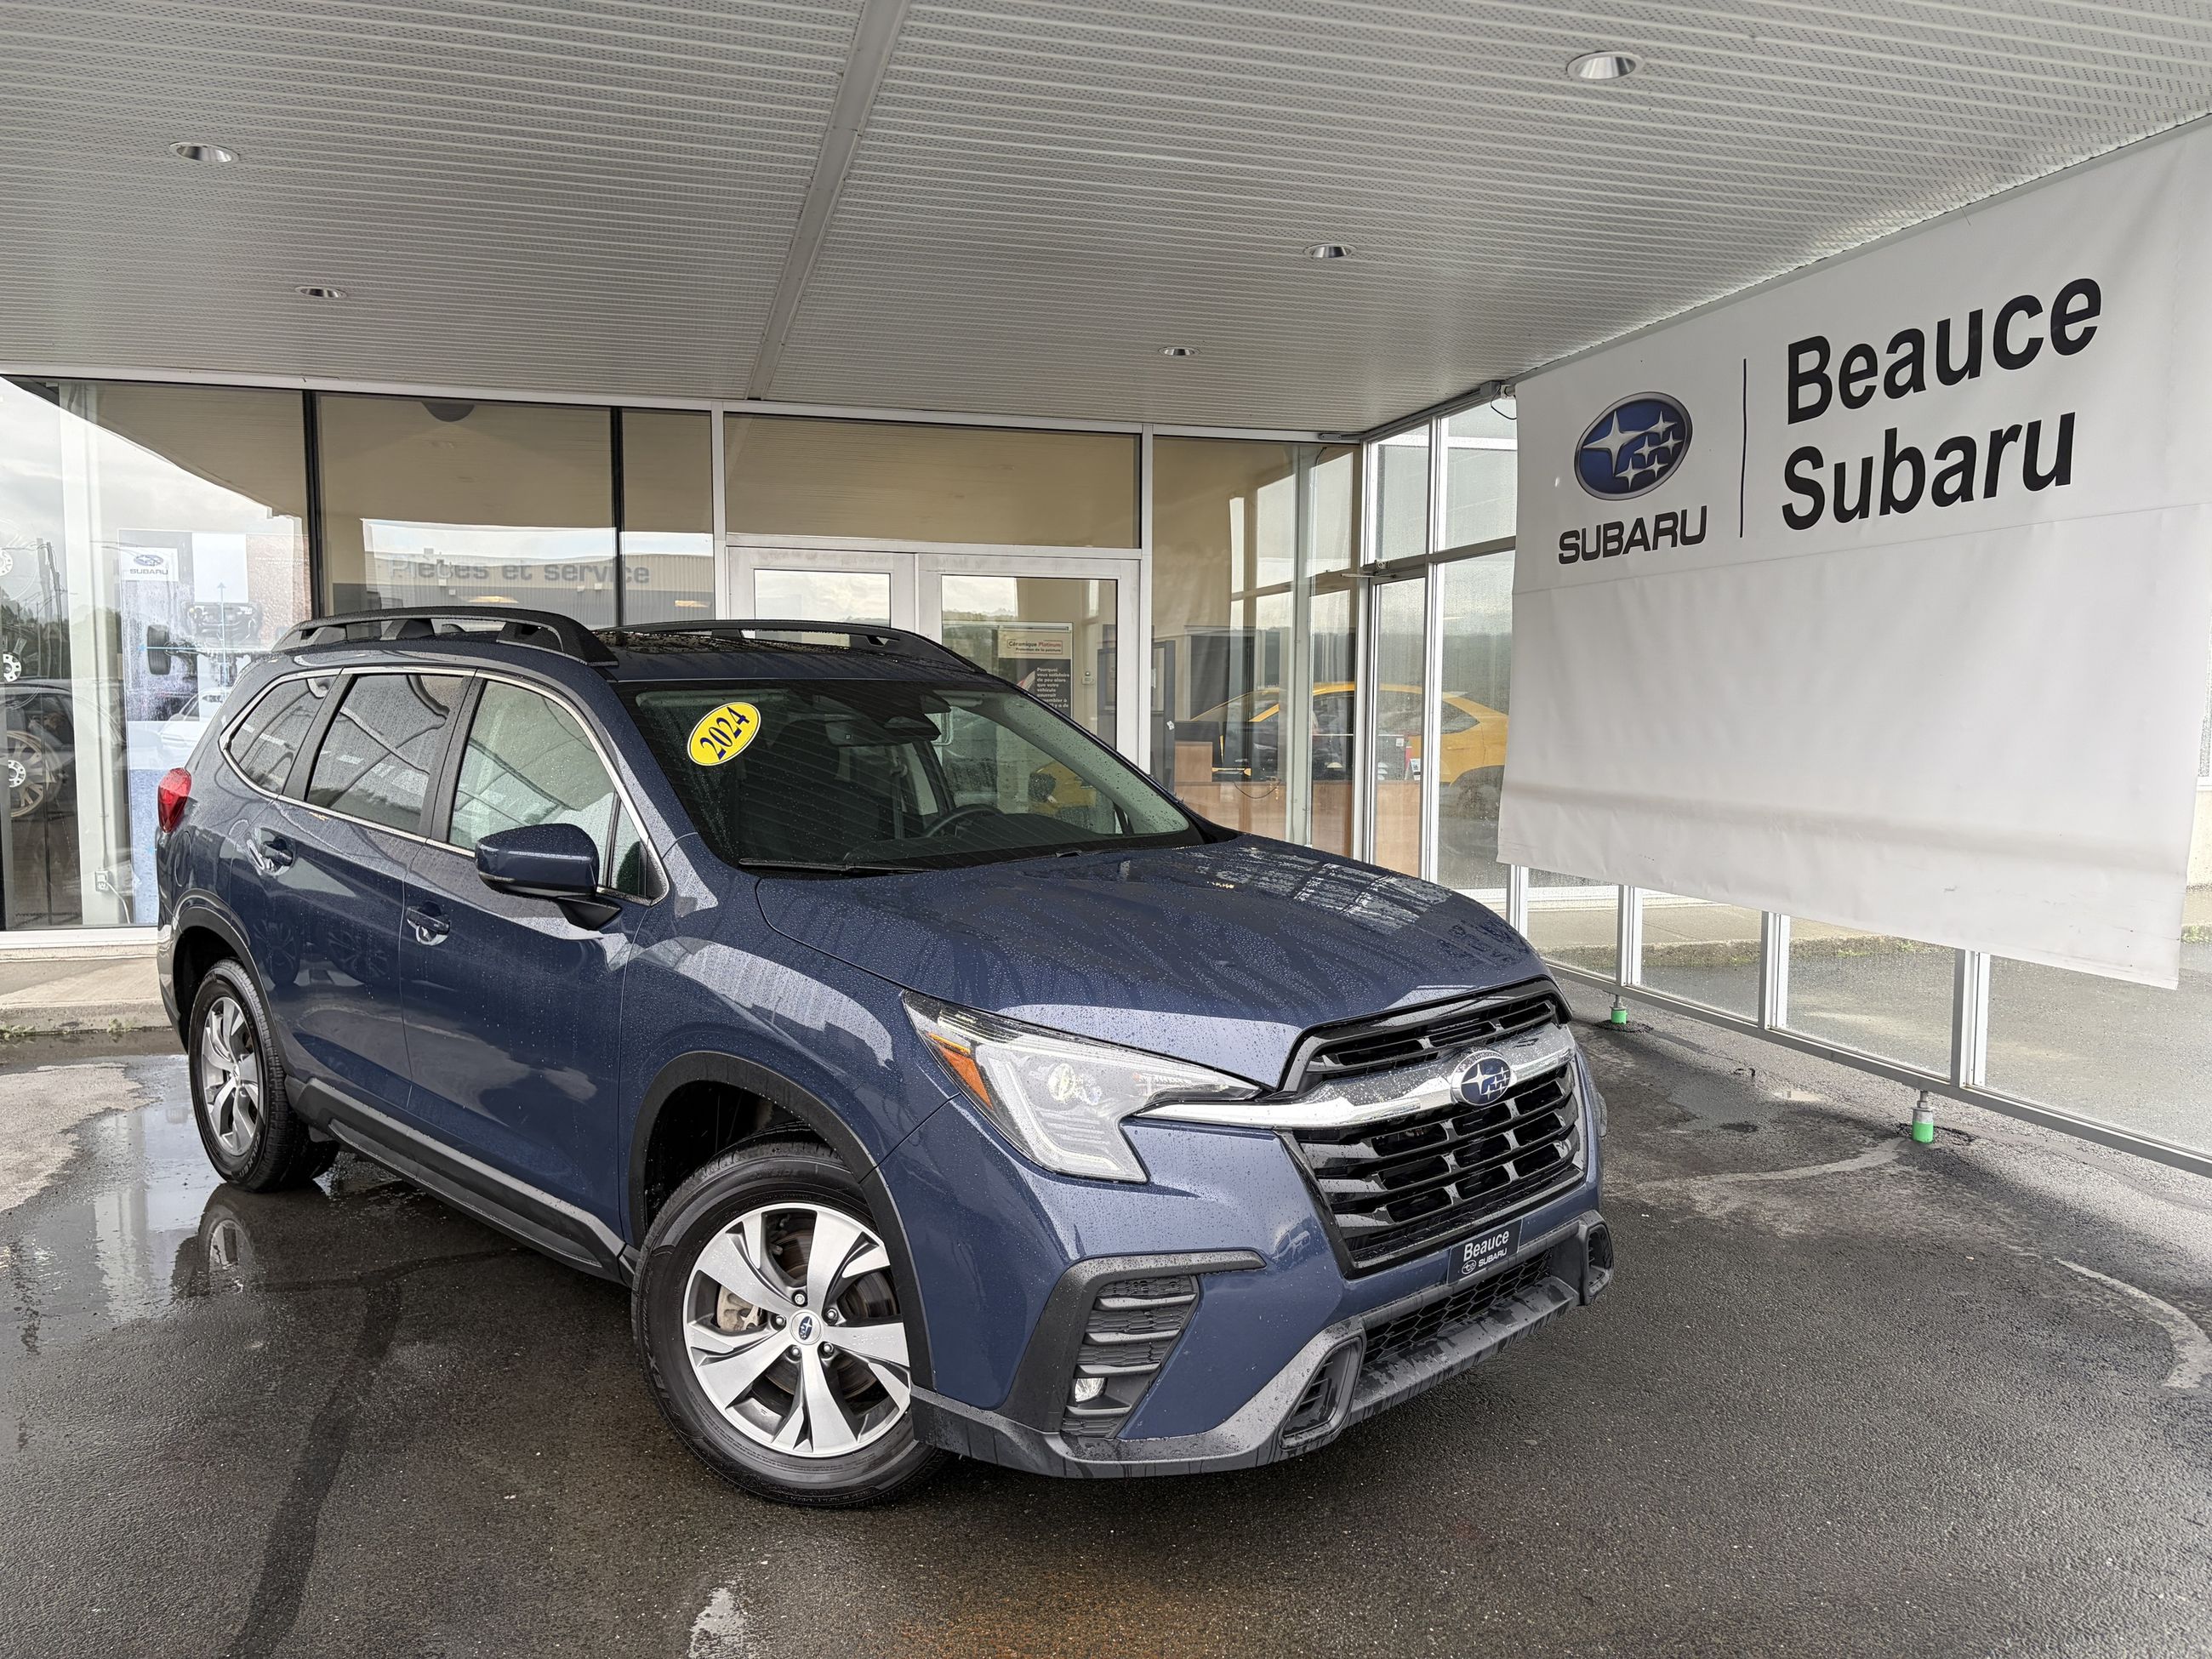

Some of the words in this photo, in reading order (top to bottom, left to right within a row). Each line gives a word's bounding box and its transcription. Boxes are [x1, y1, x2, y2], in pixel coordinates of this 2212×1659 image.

[1787, 278, 2101, 425] Beauce
[1782, 412, 2076, 531] Subaru
[1558, 505, 1707, 565] SUBARU
[501, 563, 533, 581] et
[700, 706, 750, 760] 2024
[1463, 1230, 1509, 1262] Beauce
[1478, 1248, 1508, 1267] SUBARU
